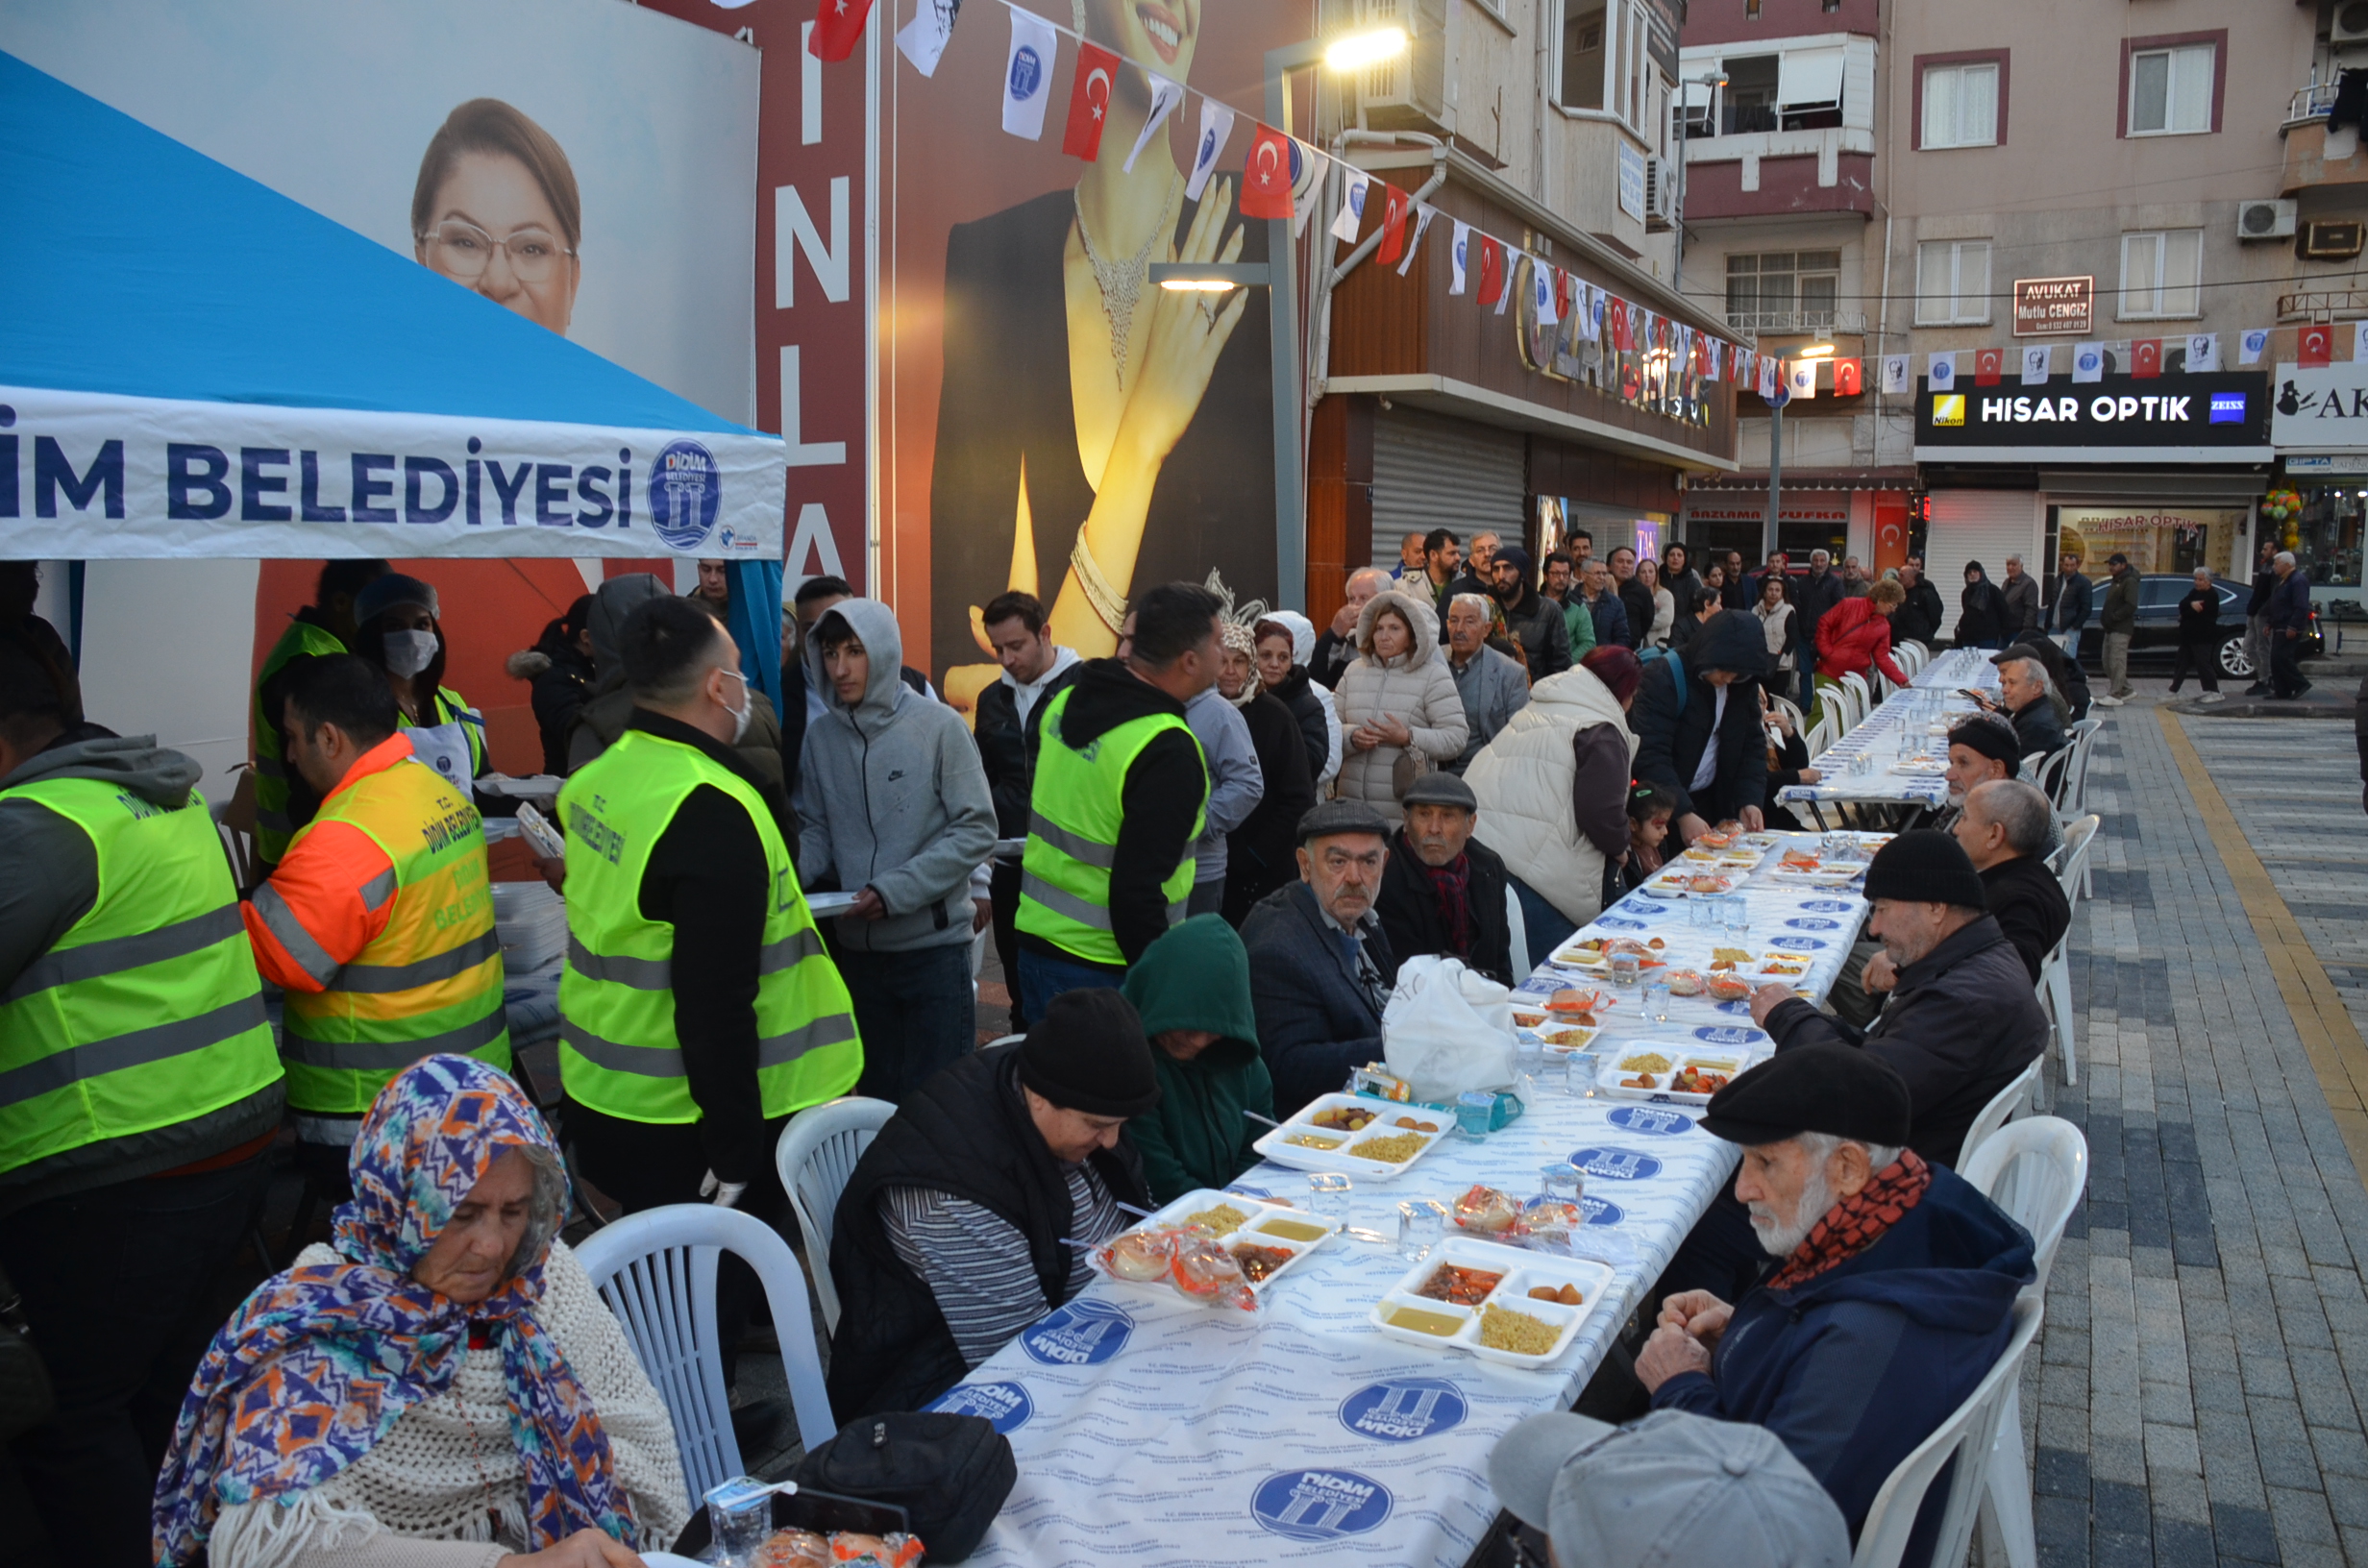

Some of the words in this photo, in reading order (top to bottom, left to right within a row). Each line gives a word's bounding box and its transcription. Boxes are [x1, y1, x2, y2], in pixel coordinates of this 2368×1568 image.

[2026, 282, 2082, 300] AVUKAT
[2019, 306, 2046, 319] Mutlu
[1982, 397, 2079, 422] HİSAR
[2090, 396, 2191, 422] OPTİK
[2211, 400, 2244, 410] ZEISS
[1934, 417, 1963, 426] Nikon
[666, 451, 706, 471] DİDİM
[167, 435, 631, 528] BELEDİYESİ
[665, 470, 706, 482] BELEDİYESİ
[2098, 515, 2144, 533] HİSAR
[2151, 515, 2199, 534] OPTİK
[436, 796, 454, 811] T.C.
[421, 816, 452, 855] DİDİM
[1030, 1335, 1090, 1363] DİDİM
[1355, 1418, 1424, 1438] DİDİM
[1296, 1482, 1367, 1507] BELEDİYESİ
[1300, 1471, 1374, 1498] DİDİM
